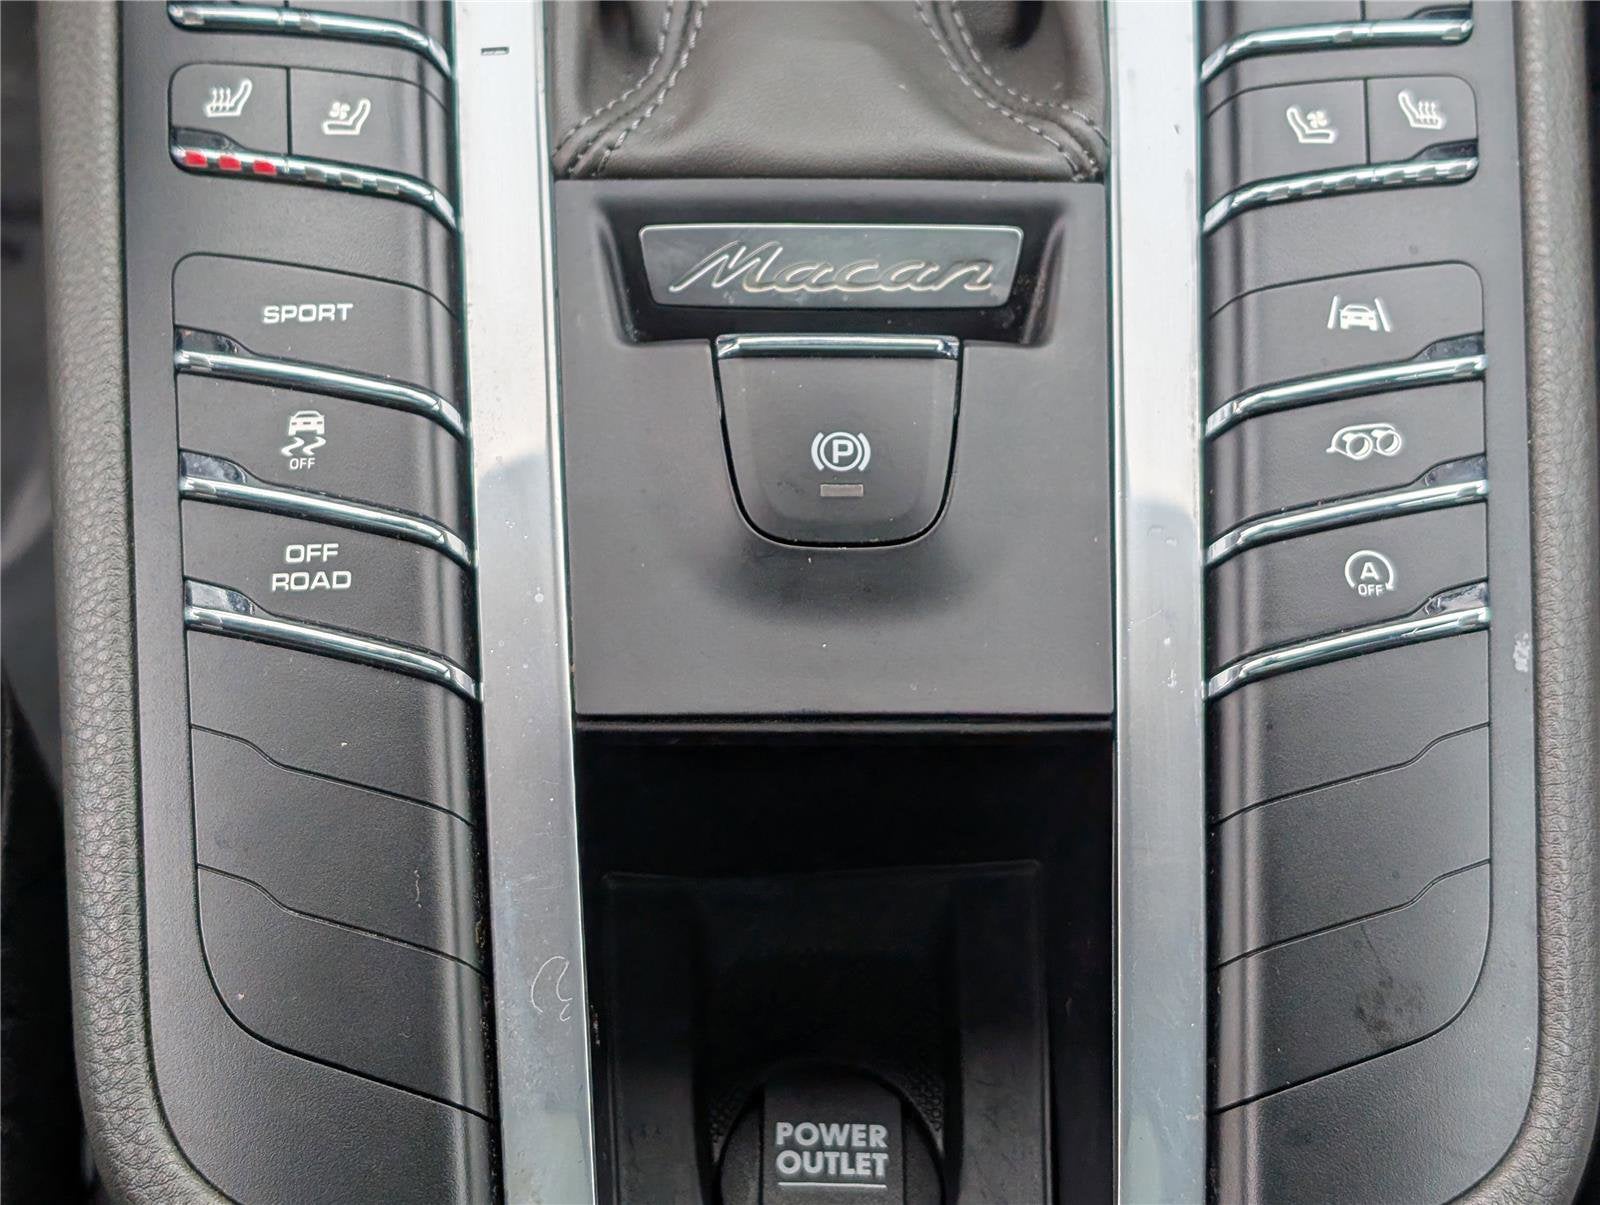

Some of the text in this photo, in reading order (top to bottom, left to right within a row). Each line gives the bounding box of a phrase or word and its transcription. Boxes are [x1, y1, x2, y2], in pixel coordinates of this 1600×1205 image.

[669, 240, 994, 292] Macan
[262, 303, 354, 325] SPORT
[832, 438, 854, 464] P
[289, 457, 316, 470] OFF
[285, 543, 339, 564] OFF
[271, 570, 352, 592] ROAD
[1360, 561, 1379, 580] A
[1357, 583, 1383, 597] OFF
[775, 1121, 888, 1148] POWER
[775, 1149, 889, 1176] OUTLET
